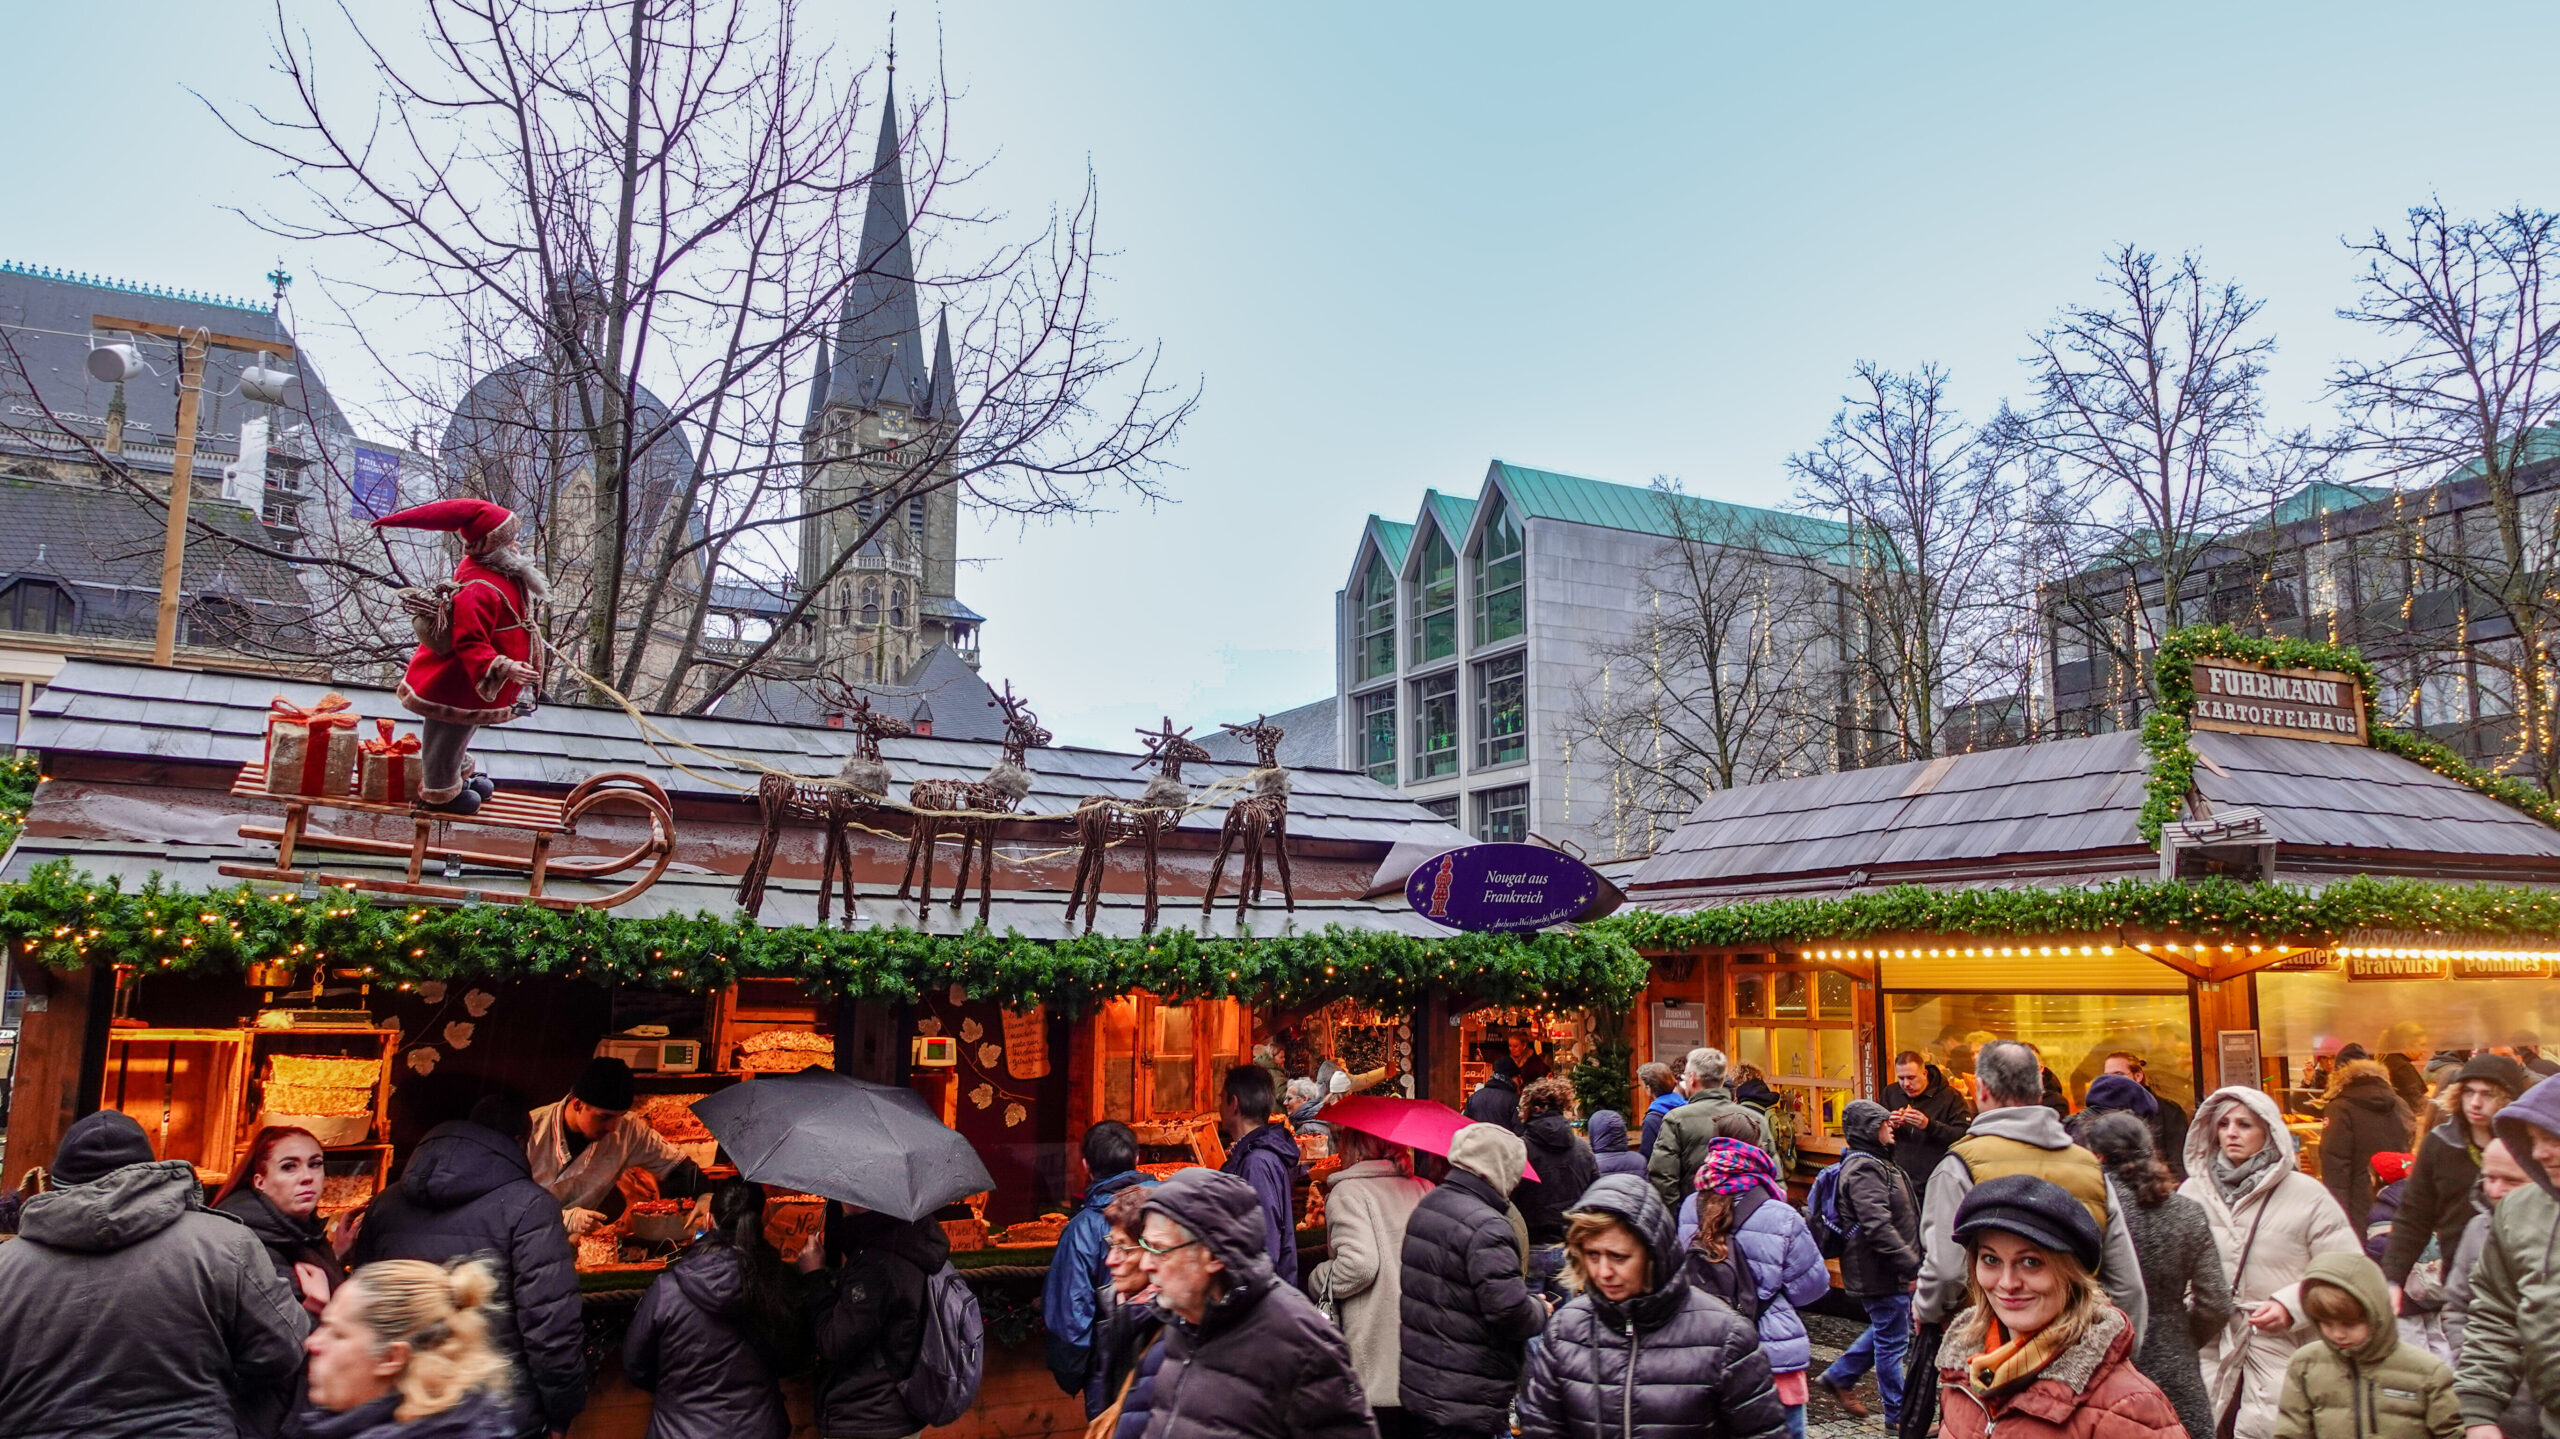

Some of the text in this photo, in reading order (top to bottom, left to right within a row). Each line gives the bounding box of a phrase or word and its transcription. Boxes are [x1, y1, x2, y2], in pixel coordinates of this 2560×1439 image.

[2207, 667, 2338, 706] FUHRMANN
[2197, 700, 2356, 734] KARTOFFELHAUS
[1485, 870, 1549, 887] Nougat aus
[1482, 890, 1544, 903] Frankreich
[2353, 957, 2439, 975] Bratwurst
